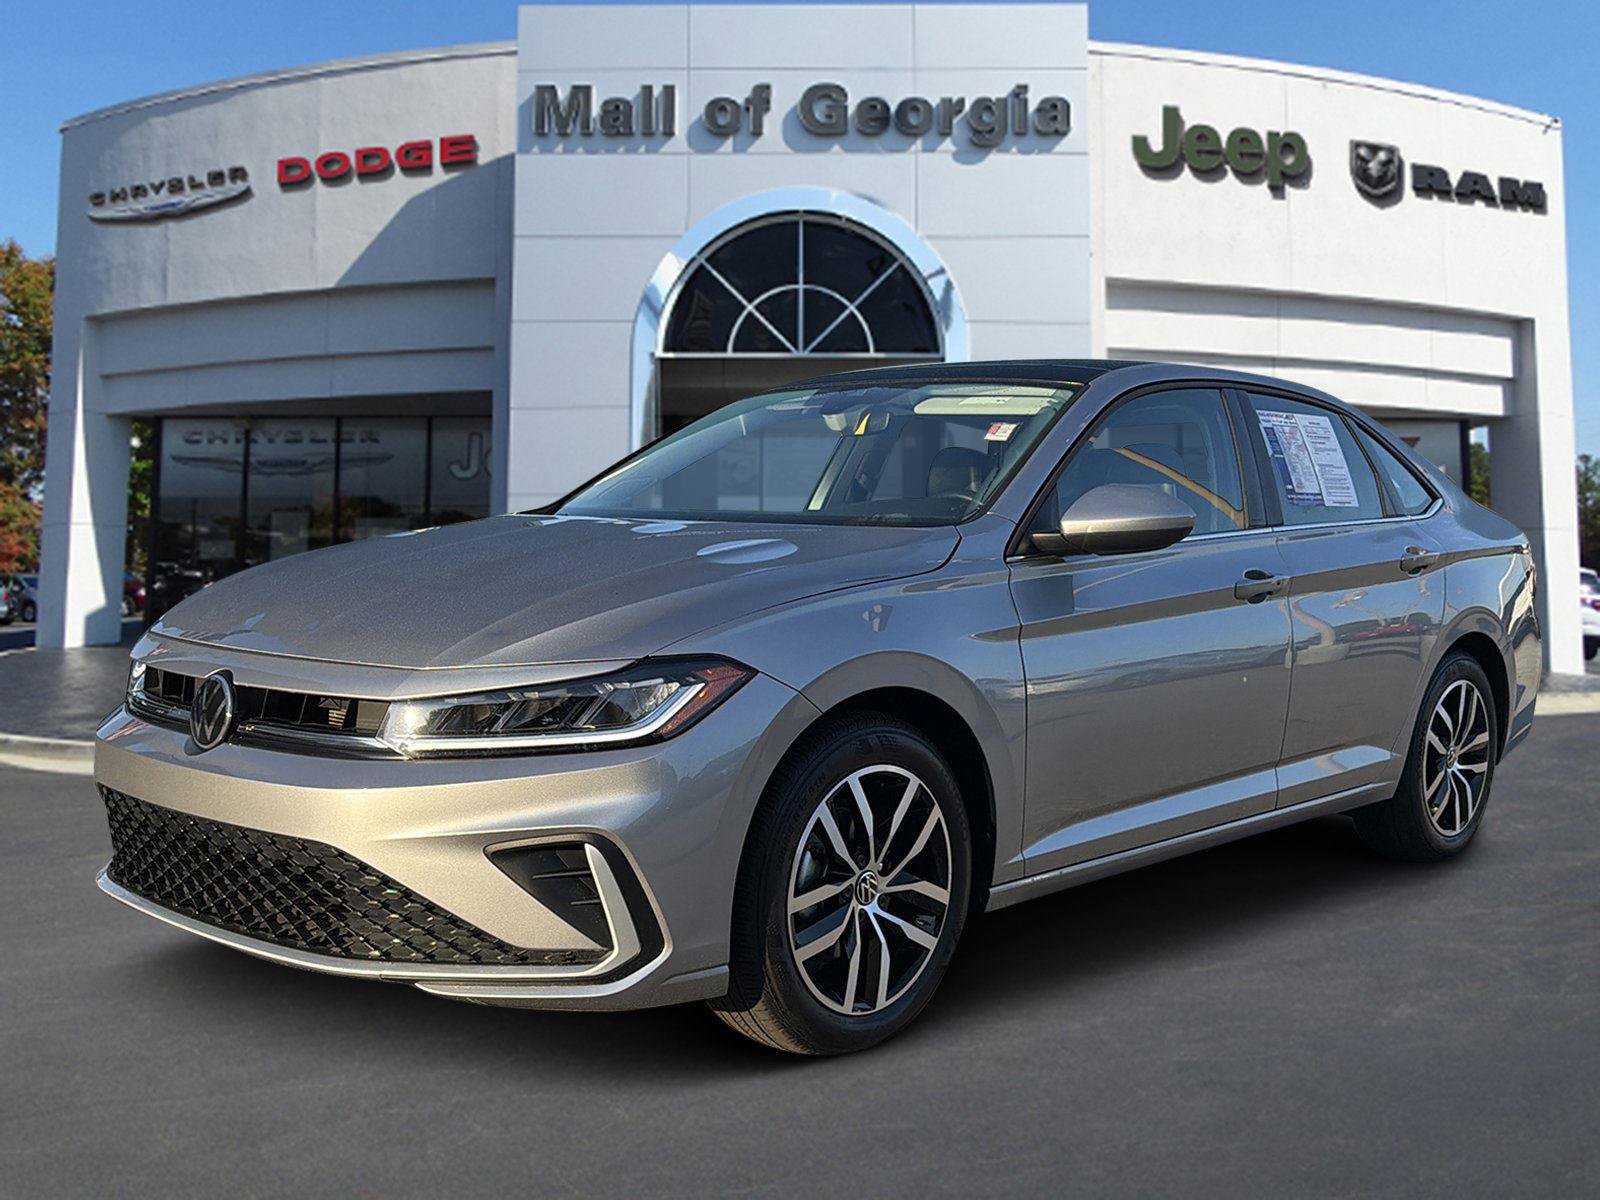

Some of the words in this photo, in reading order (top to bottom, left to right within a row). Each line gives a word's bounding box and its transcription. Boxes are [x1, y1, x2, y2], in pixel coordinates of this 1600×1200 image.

[533, 84, 677, 137] Mall
[704, 82, 772, 136] of
[799, 82, 1072, 149] Georgia
[277, 134, 478, 188] DODGE
[1132, 105, 1309, 192] Jeep
[89, 166, 250, 207] CHRYSLER
[1411, 163, 1547, 213] RAM
